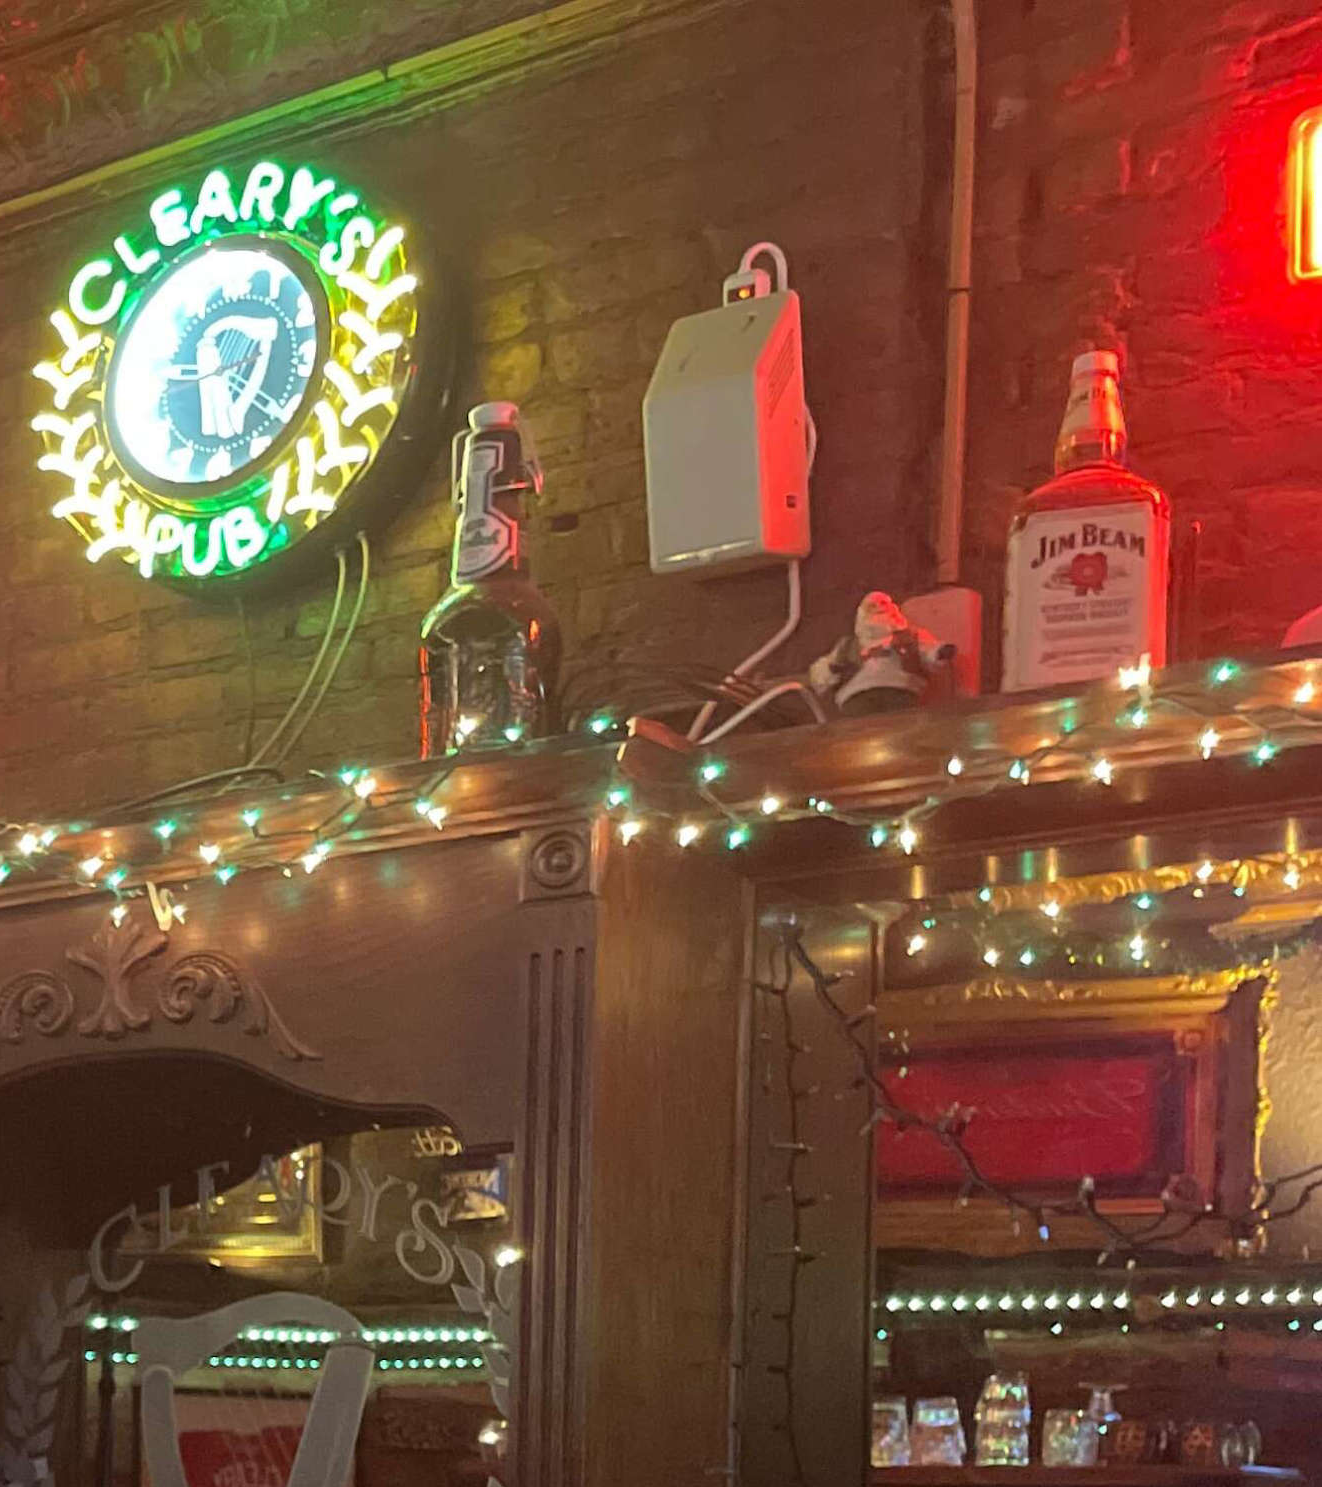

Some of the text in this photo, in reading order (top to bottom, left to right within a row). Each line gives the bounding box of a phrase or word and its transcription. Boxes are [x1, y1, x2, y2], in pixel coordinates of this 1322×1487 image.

[68, 161, 376, 326] CLEARY'S
[135, 505, 266, 579] PUB
[1030, 523, 1145, 569] JIM BEAM
